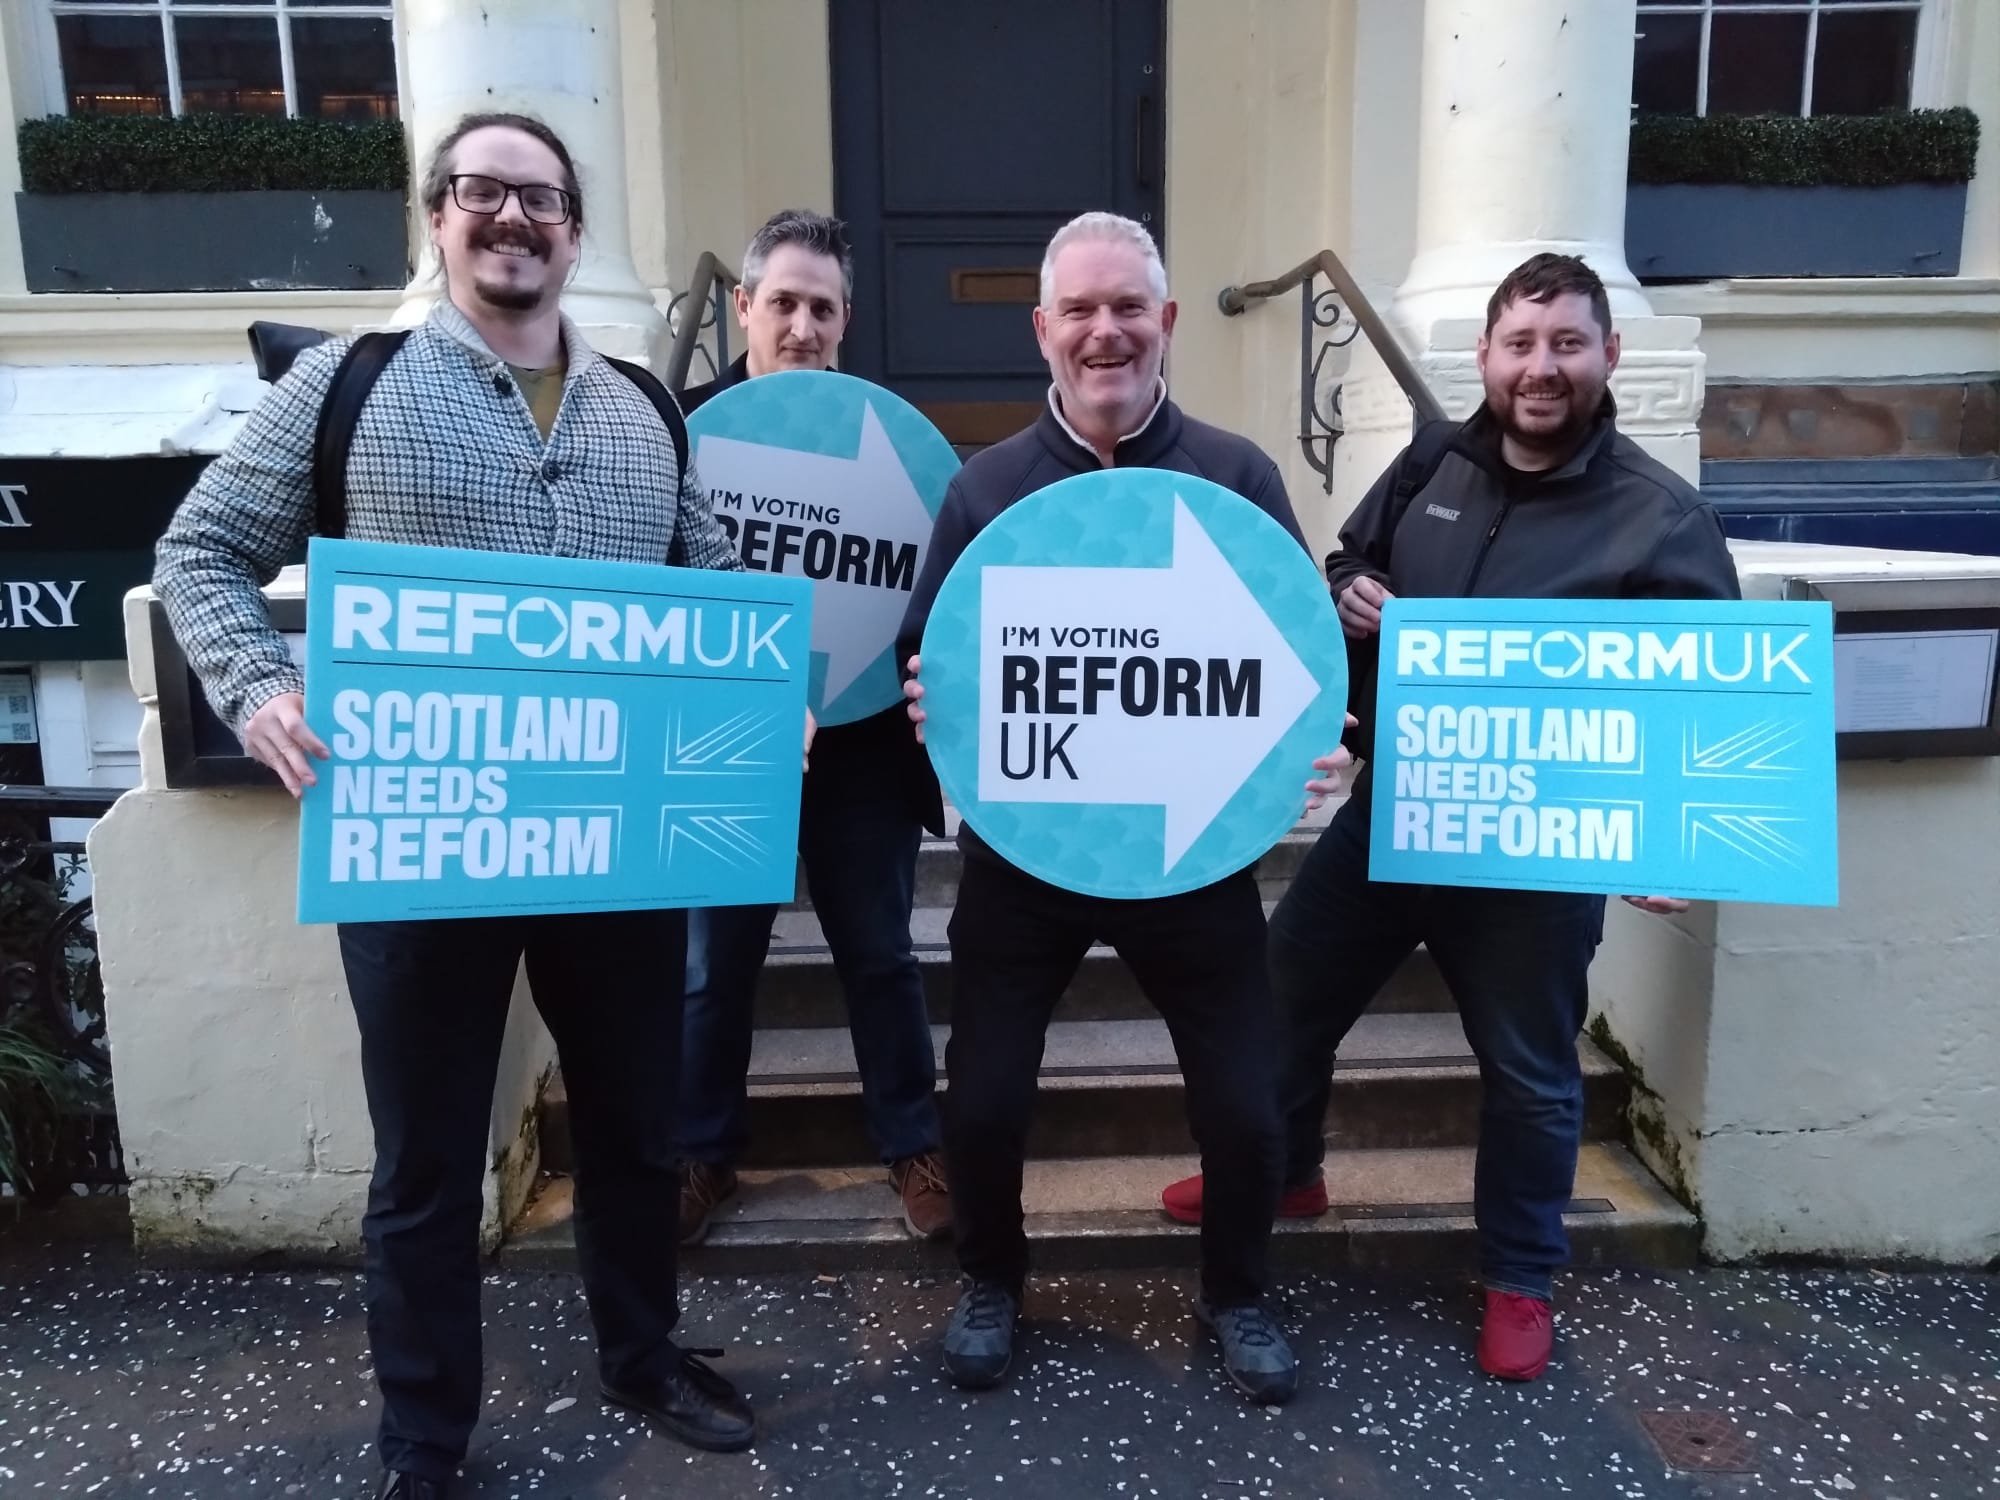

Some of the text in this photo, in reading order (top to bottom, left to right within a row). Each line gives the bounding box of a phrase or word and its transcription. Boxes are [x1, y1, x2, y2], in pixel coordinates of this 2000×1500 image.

[751, 495, 841, 525] VOTING
[1050, 627, 1160, 648] VOTING
[1001, 655, 1262, 718] REFORM
[331, 689, 620, 763] SCOTLAND
[1000, 722, 1079, 781] UK
[1396, 704, 1636, 764] SCOTLAND
[332, 765, 508, 815] NEEDS
[1395, 761, 1537, 802] NEEDS
[329, 815, 612, 883] REFORM
[1393, 800, 1634, 862] REFORM
